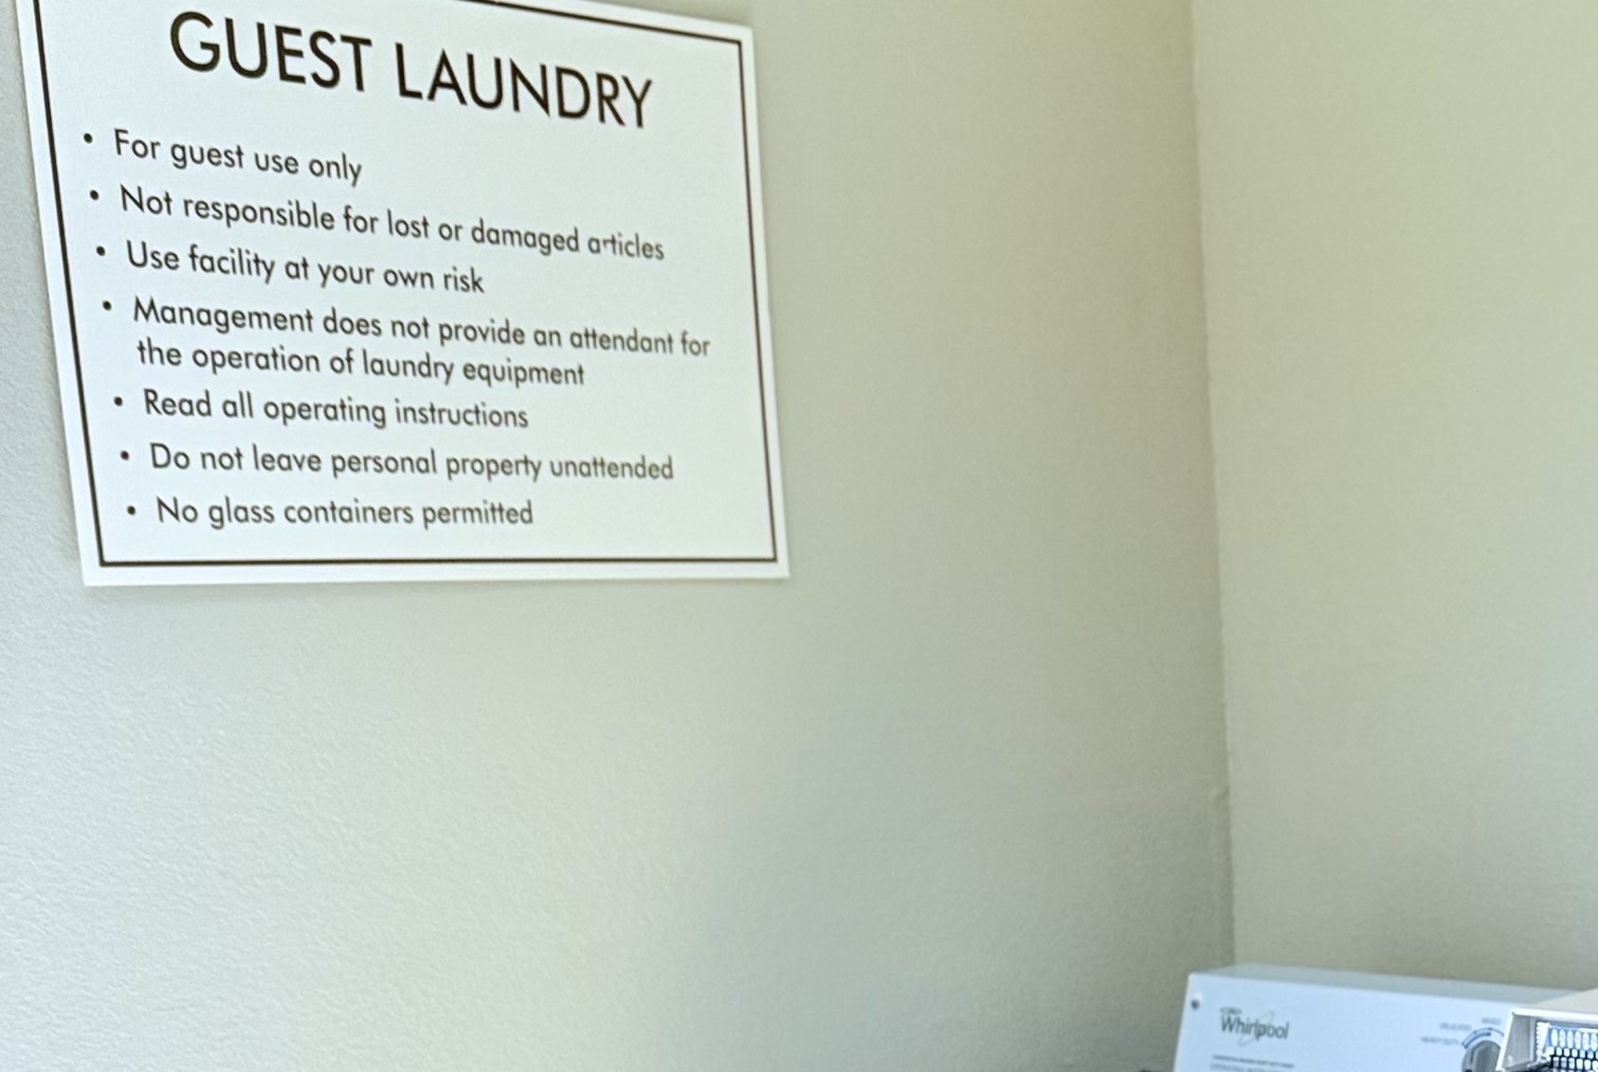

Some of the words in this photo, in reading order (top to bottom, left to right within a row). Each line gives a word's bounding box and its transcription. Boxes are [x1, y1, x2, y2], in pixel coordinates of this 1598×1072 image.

[169, 10, 373, 93] GUEST
[394, 42, 653, 129] LAUNDRY
[114, 128, 161, 160] For
[170, 143, 244, 170] guest
[254, 152, 299, 175] use
[308, 152, 362, 188] only
[120, 183, 173, 216] Not
[183, 198, 335, 231] responsible
[342, 204, 380, 234] for
[387, 208, 430, 239] lost
[437, 222, 463, 242] or
[470, 217, 580, 257] damaged
[587, 232, 665, 261] articles
[126, 239, 180, 271] Use
[188, 243, 276, 285] facility
[284, 256, 309, 280] at
[317, 263, 375, 289] your
[383, 268, 435, 290] own
[443, 266, 485, 294] risk
[133, 295, 314, 335] Management
[322, 306, 382, 337] does
[391, 316, 430, 339] not
[438, 318, 526, 347] provide
[533, 329, 562, 347] an
[569, 327, 674, 354] attendant
[680, 330, 710, 356] for
[136, 336, 182, 367] the
[191, 344, 321, 375] operation
[329, 347, 354, 375] of
[362, 348, 455, 386] laundry
[462, 357, 585, 389] equipment
[143, 388, 212, 417] Read
[222, 390, 254, 418] all
[263, 396, 387, 430] operating
[394, 397, 529, 428] instructions
[150, 442, 190, 470] Do
[200, 447, 243, 471] not
[252, 443, 322, 472] leave
[331, 448, 437, 479] personal
[446, 454, 542, 482] property
[550, 455, 674, 480] unattended
[156, 496, 199, 523] No
[208, 496, 275, 530] glass
[284, 498, 414, 524] containers
[422, 499, 533, 530] permitted
[1220, 1015, 1290, 1041] Whirlpool
